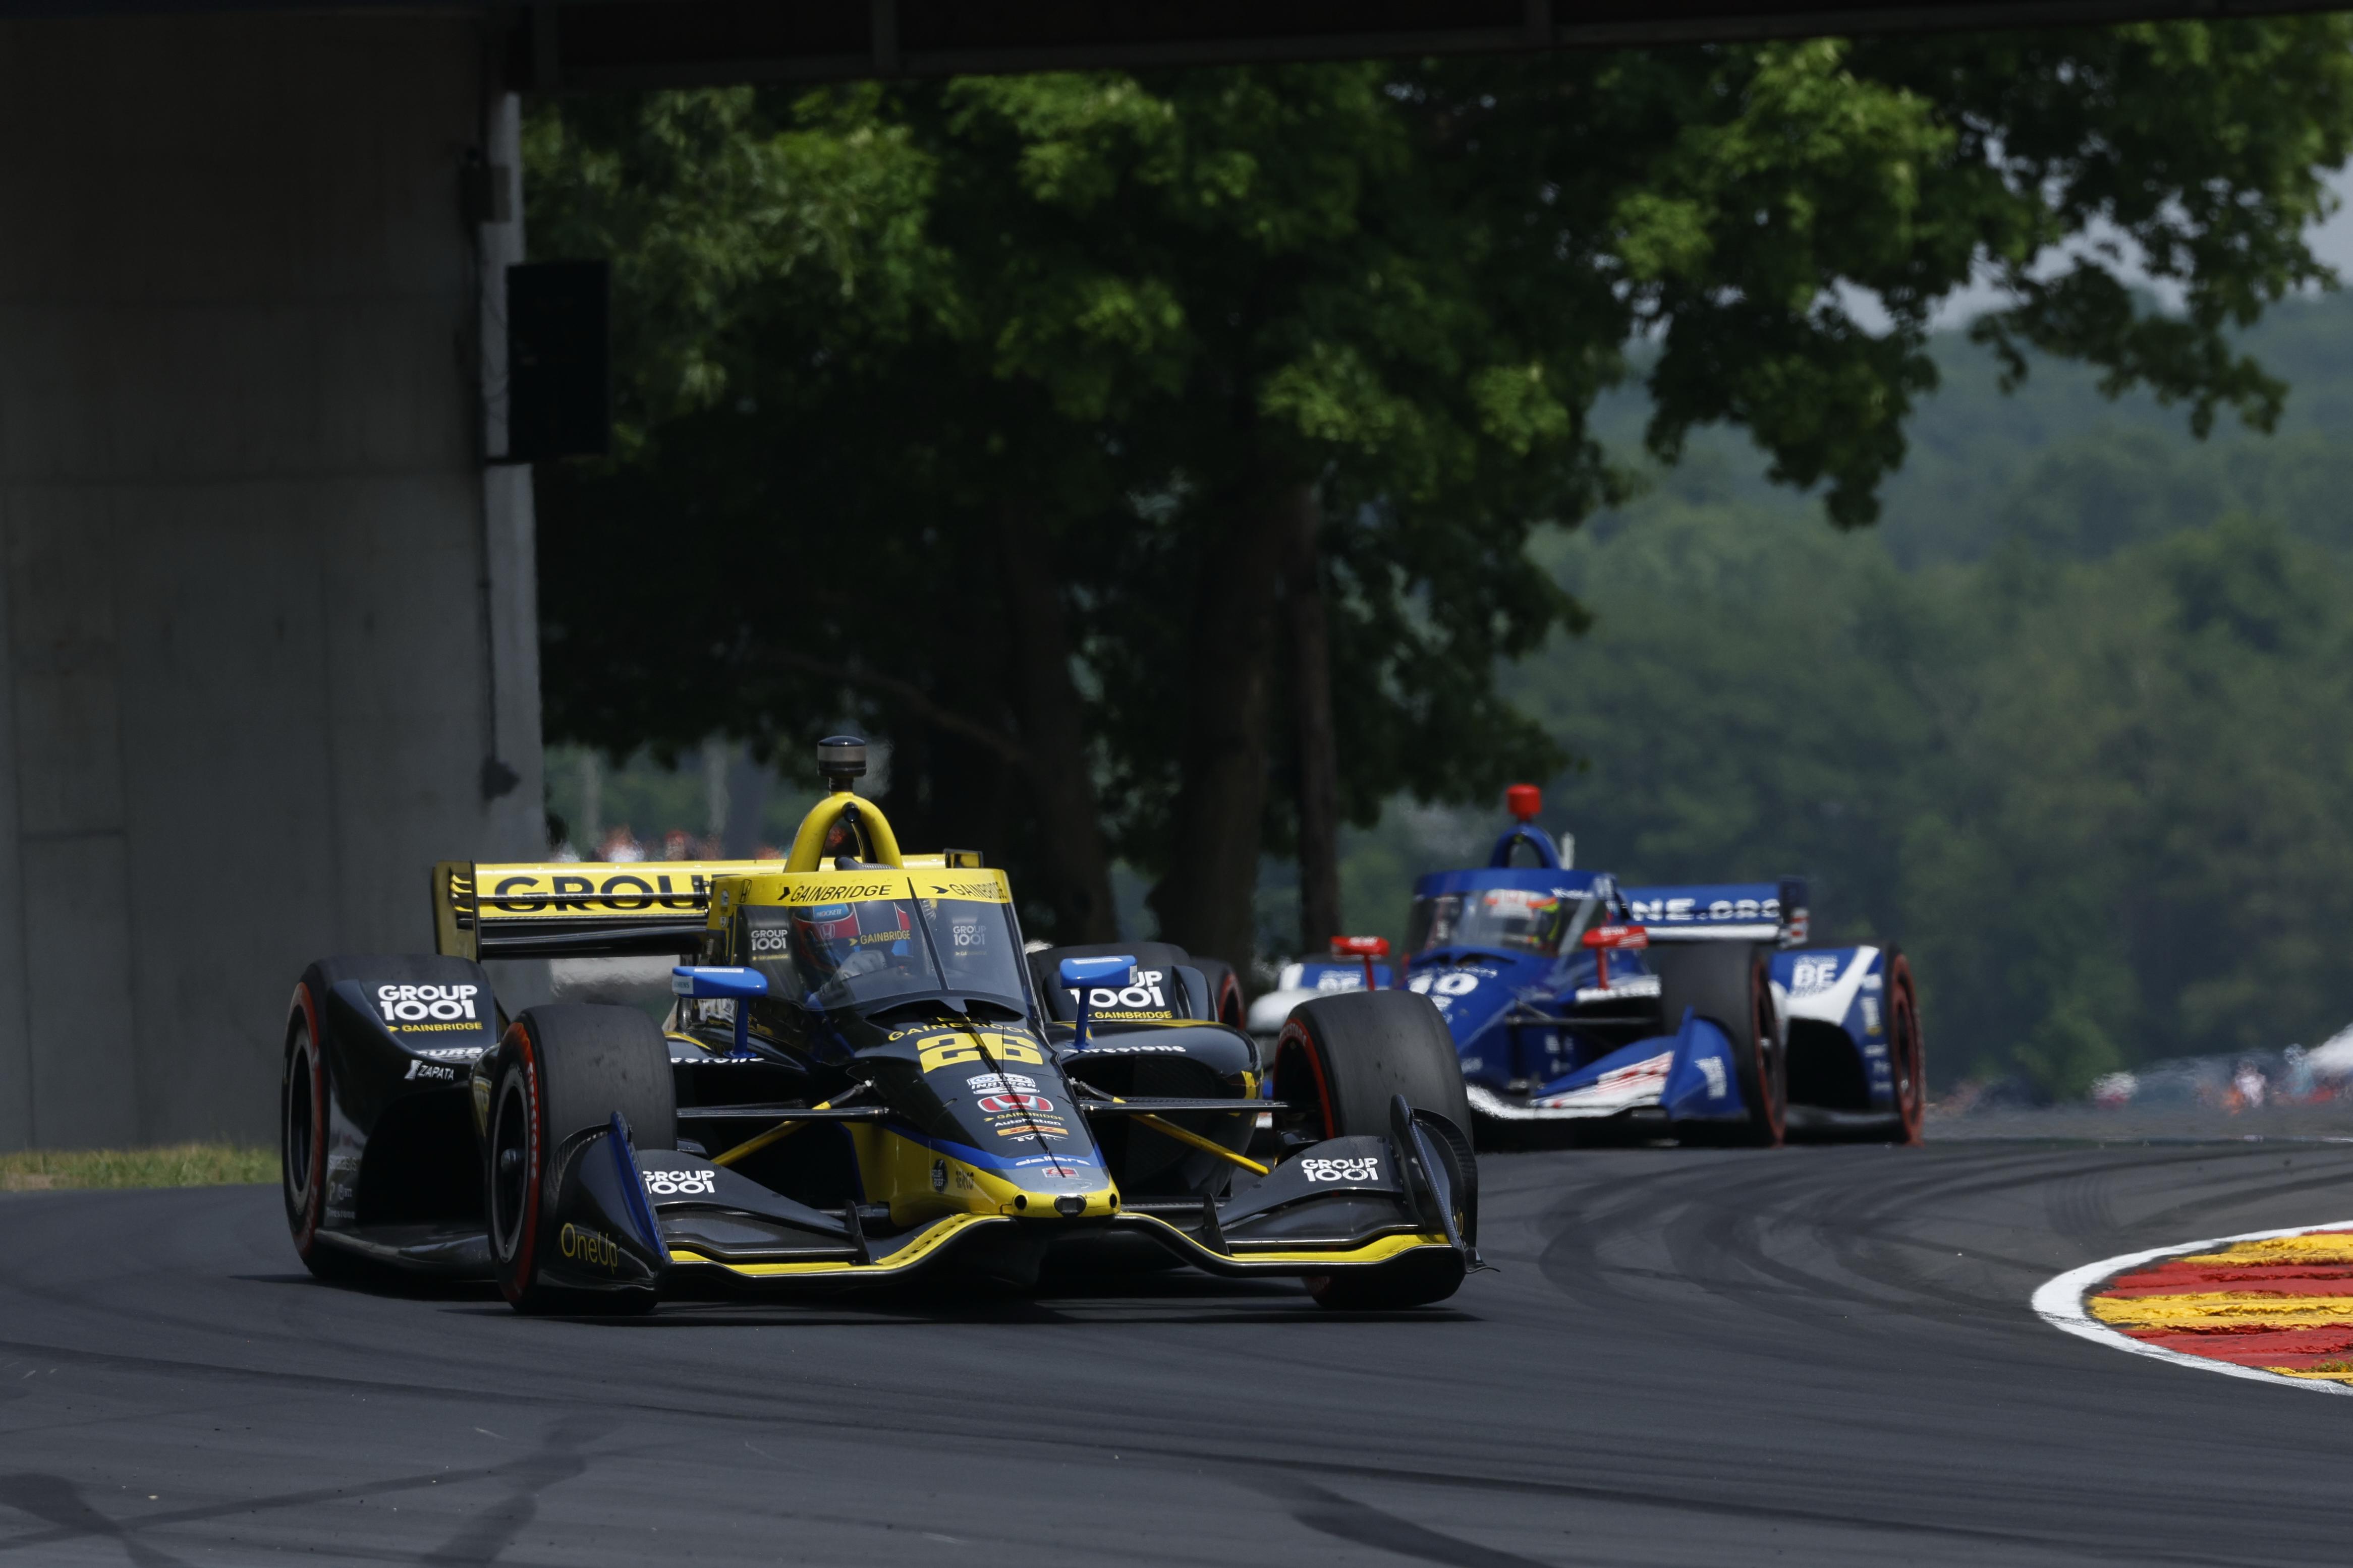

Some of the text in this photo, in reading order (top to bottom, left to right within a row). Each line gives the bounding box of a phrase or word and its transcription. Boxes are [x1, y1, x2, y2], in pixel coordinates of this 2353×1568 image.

[494, 875, 710, 913] GROU
[790, 884, 892, 902] GAINBRIDGE
[1632, 898, 1780, 921] NE.ORG
[751, 929, 788, 938] GROUP
[953, 925, 986, 934] GROUP
[751, 937, 787, 951] 1001
[860, 930, 911, 945] GAINBRIDGE
[953, 933, 985, 946] 1001
[377, 985, 477, 1001] GROUP
[1070, 987, 1166, 1008] 1001
[379, 1001, 476, 1021] 1001
[1094, 1011, 1172, 1019] GAINBRIDGE
[402, 1022, 483, 1032] GAINBRIDGE
[916, 1032, 1043, 1074] 26
[418, 1065, 455, 1081] ZAPATA
[997, 1112, 1065, 1121] GAINBRIDGE
[1301, 1158, 1378, 1170] GROUP
[642, 1170, 715, 1181] GROUP
[1304, 1168, 1378, 1182] 1001
[561, 1223, 618, 1275] OneUp
